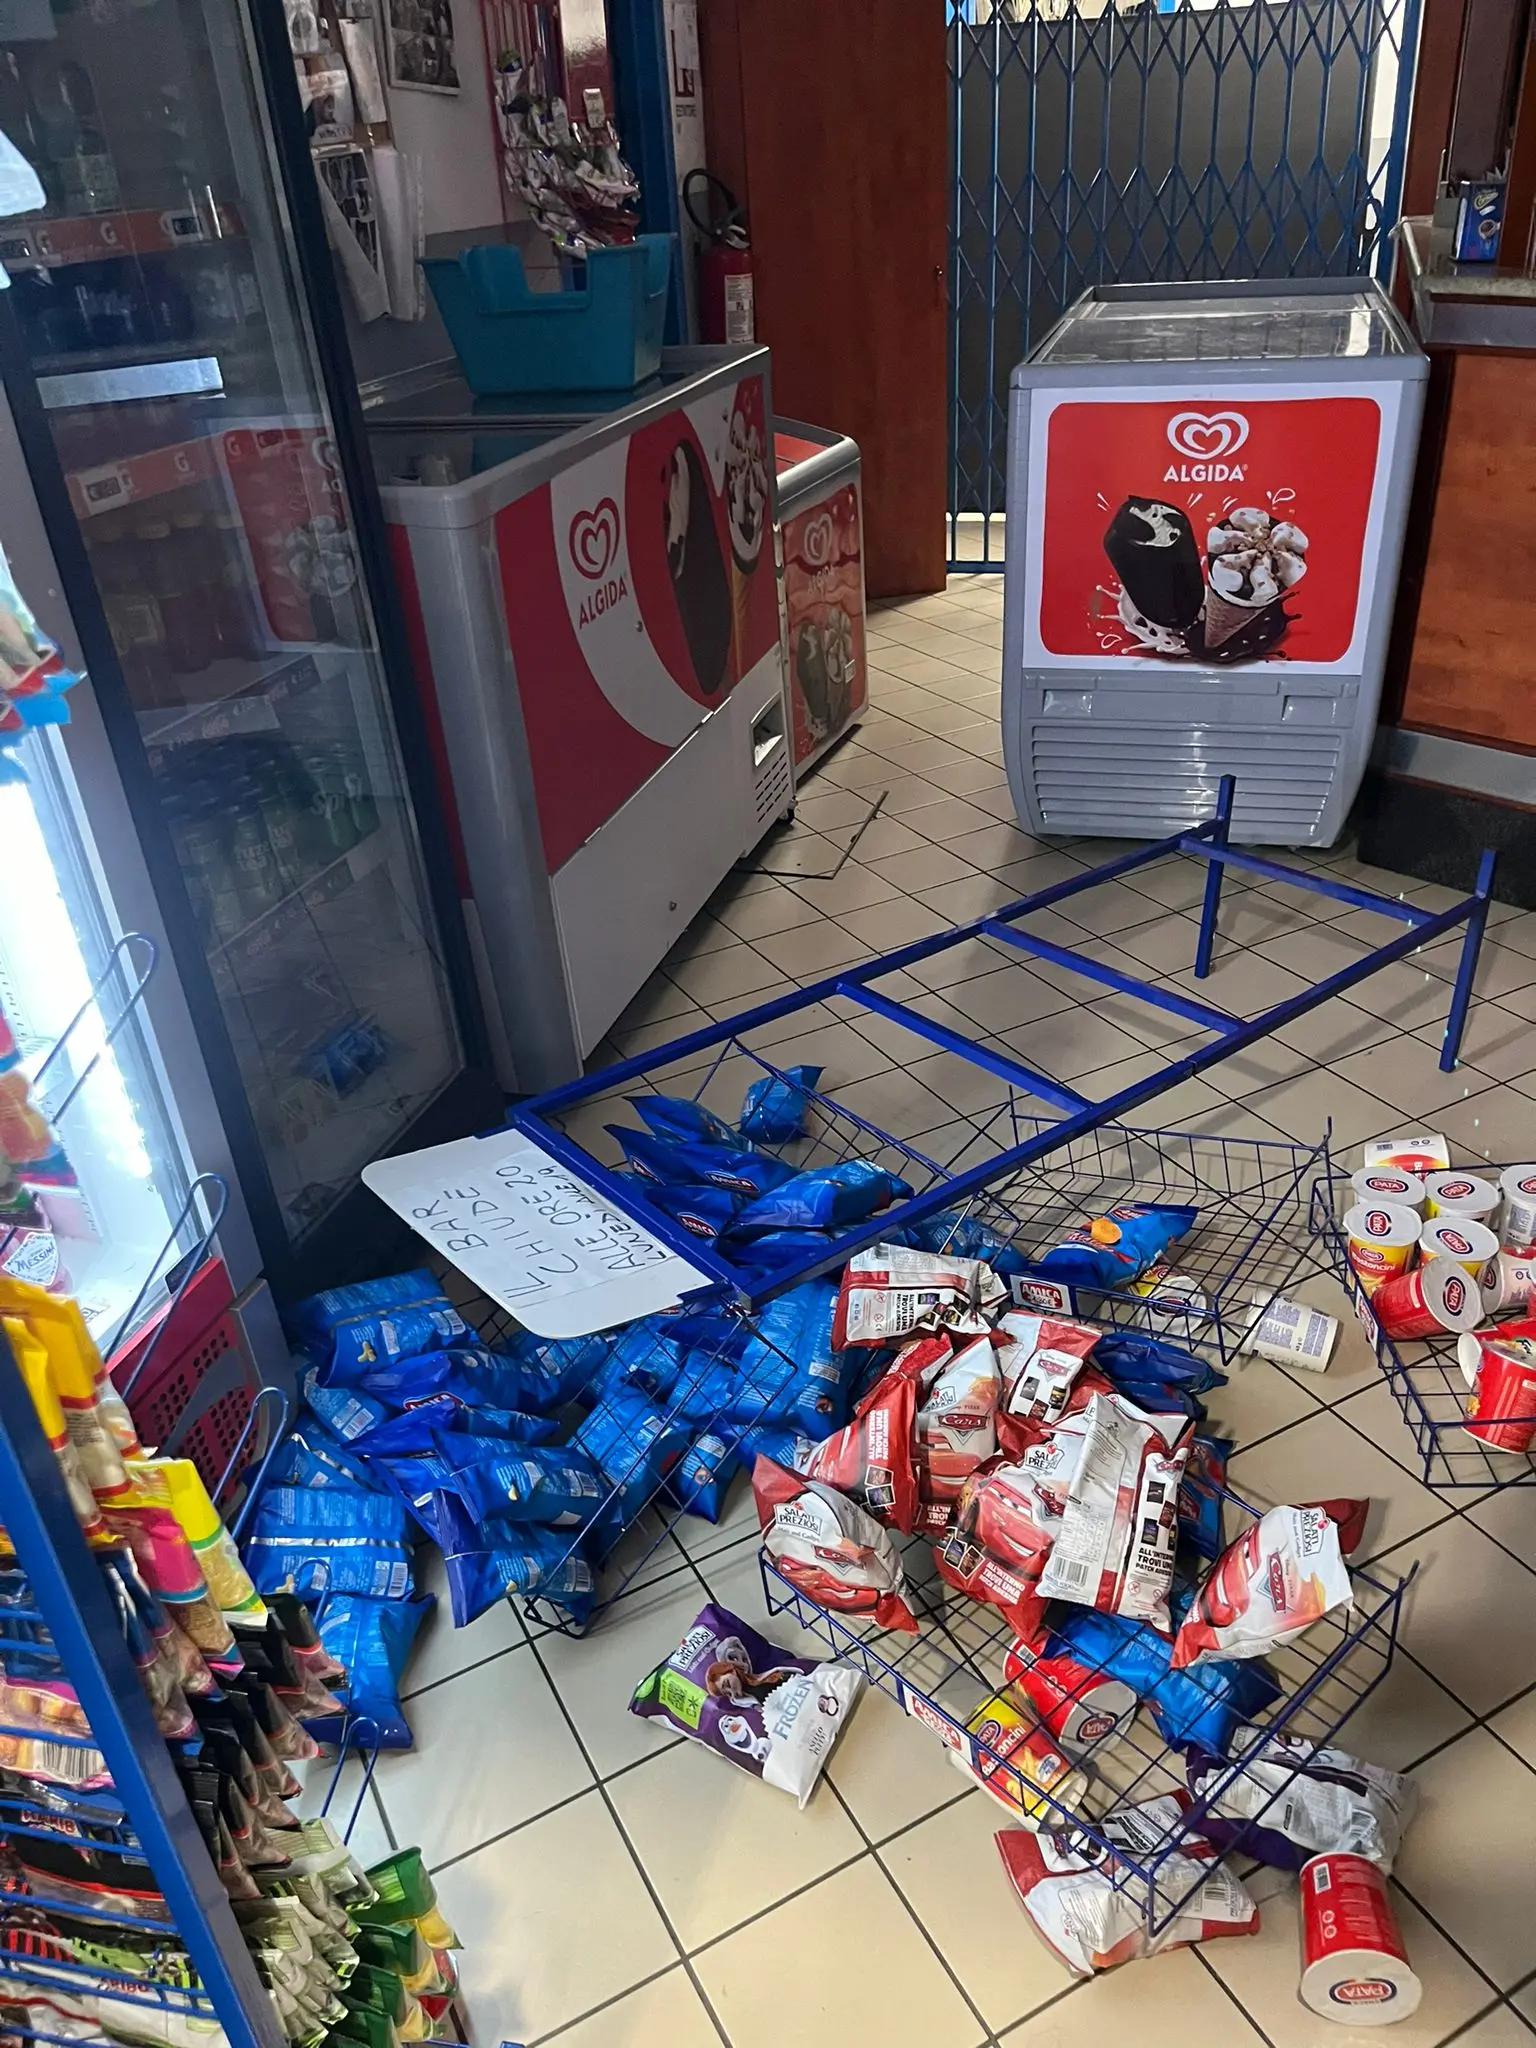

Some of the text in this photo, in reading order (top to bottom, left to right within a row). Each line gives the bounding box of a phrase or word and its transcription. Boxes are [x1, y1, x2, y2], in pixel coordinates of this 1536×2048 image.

[1163, 464, 1245, 482] ALGIDA
[579, 574, 628, 630] ALGIDA
[538, 1165, 569, 1181] 19
[443, 1186, 579, 1274] CHIUDE
[495, 1165, 646, 1270] ALLE ORE 20
[411, 1199, 552, 1299] IL BAR
[1022, 1284, 1060, 1300] AMICA
[773, 1679, 814, 1741] FROZEN
[982, 1721, 1027, 1776] Basoncini
[1342, 1985, 1384, 1998] PATA
